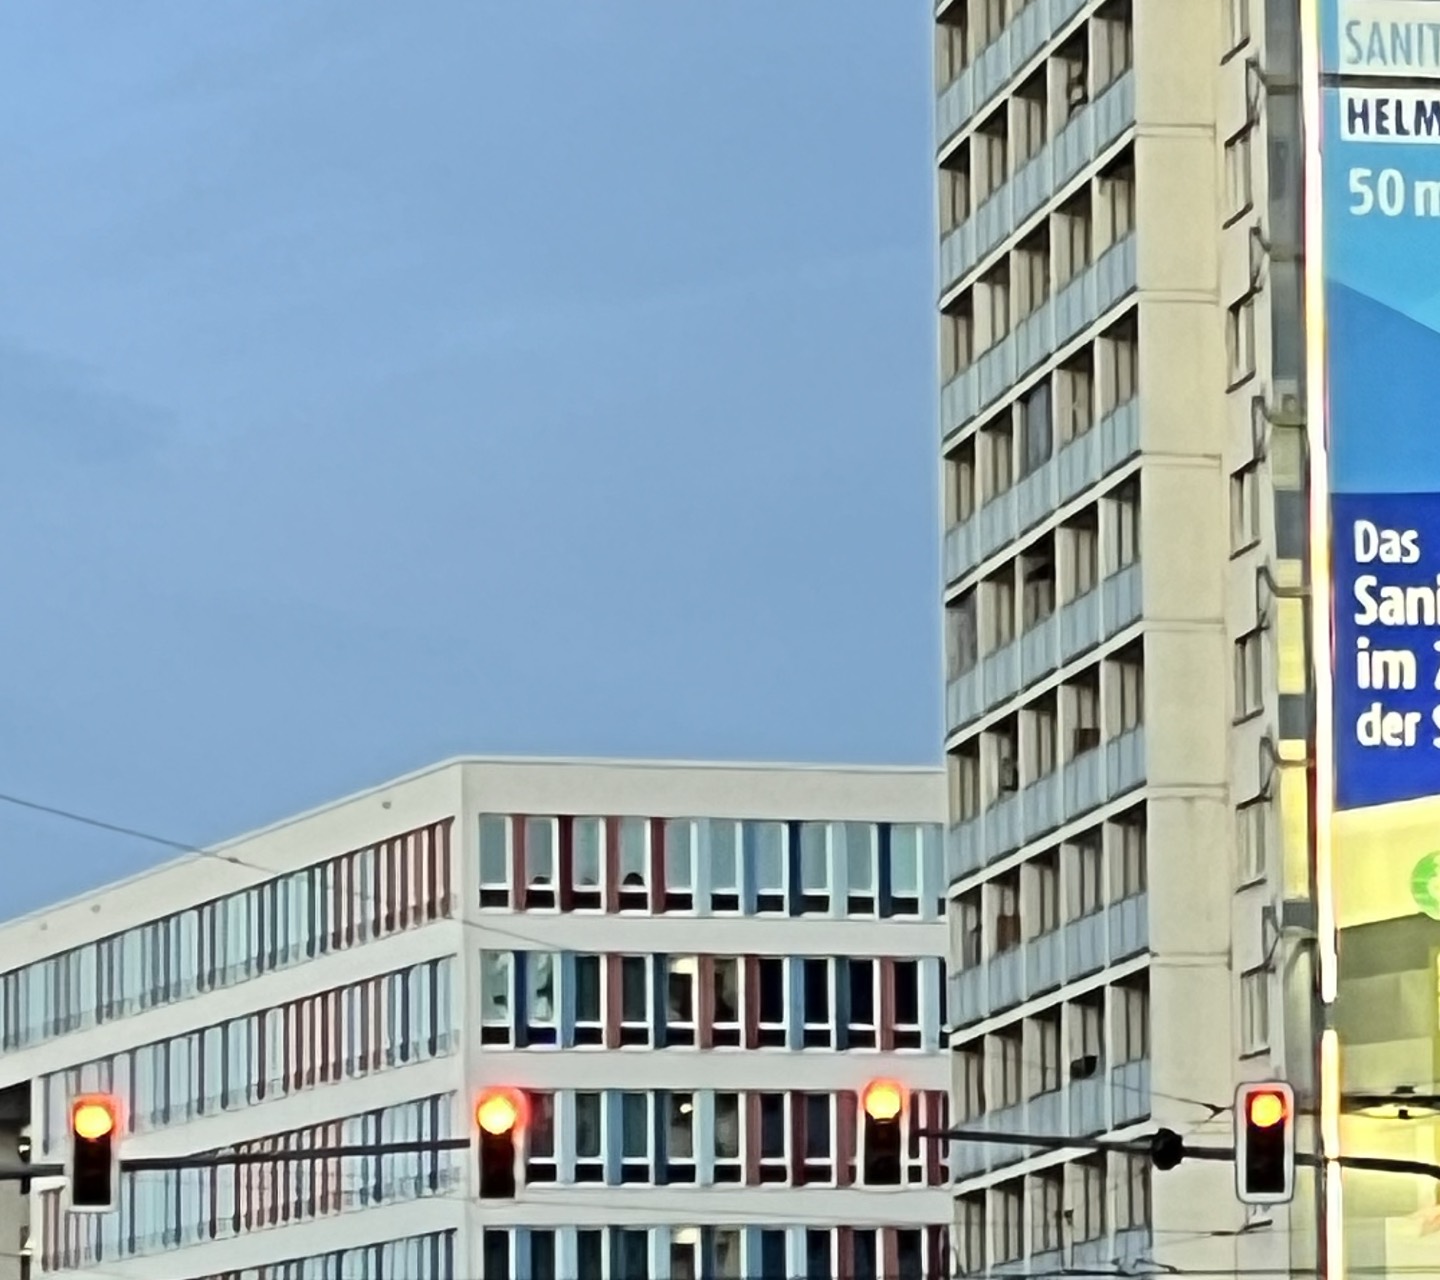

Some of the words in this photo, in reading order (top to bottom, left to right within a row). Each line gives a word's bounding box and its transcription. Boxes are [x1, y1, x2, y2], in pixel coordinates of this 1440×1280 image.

[1349, 168, 1405, 217] 50
[1353, 519, 1421, 564] Das
[1356, 636, 1417, 690] im
[1356, 702, 1422, 747] der
